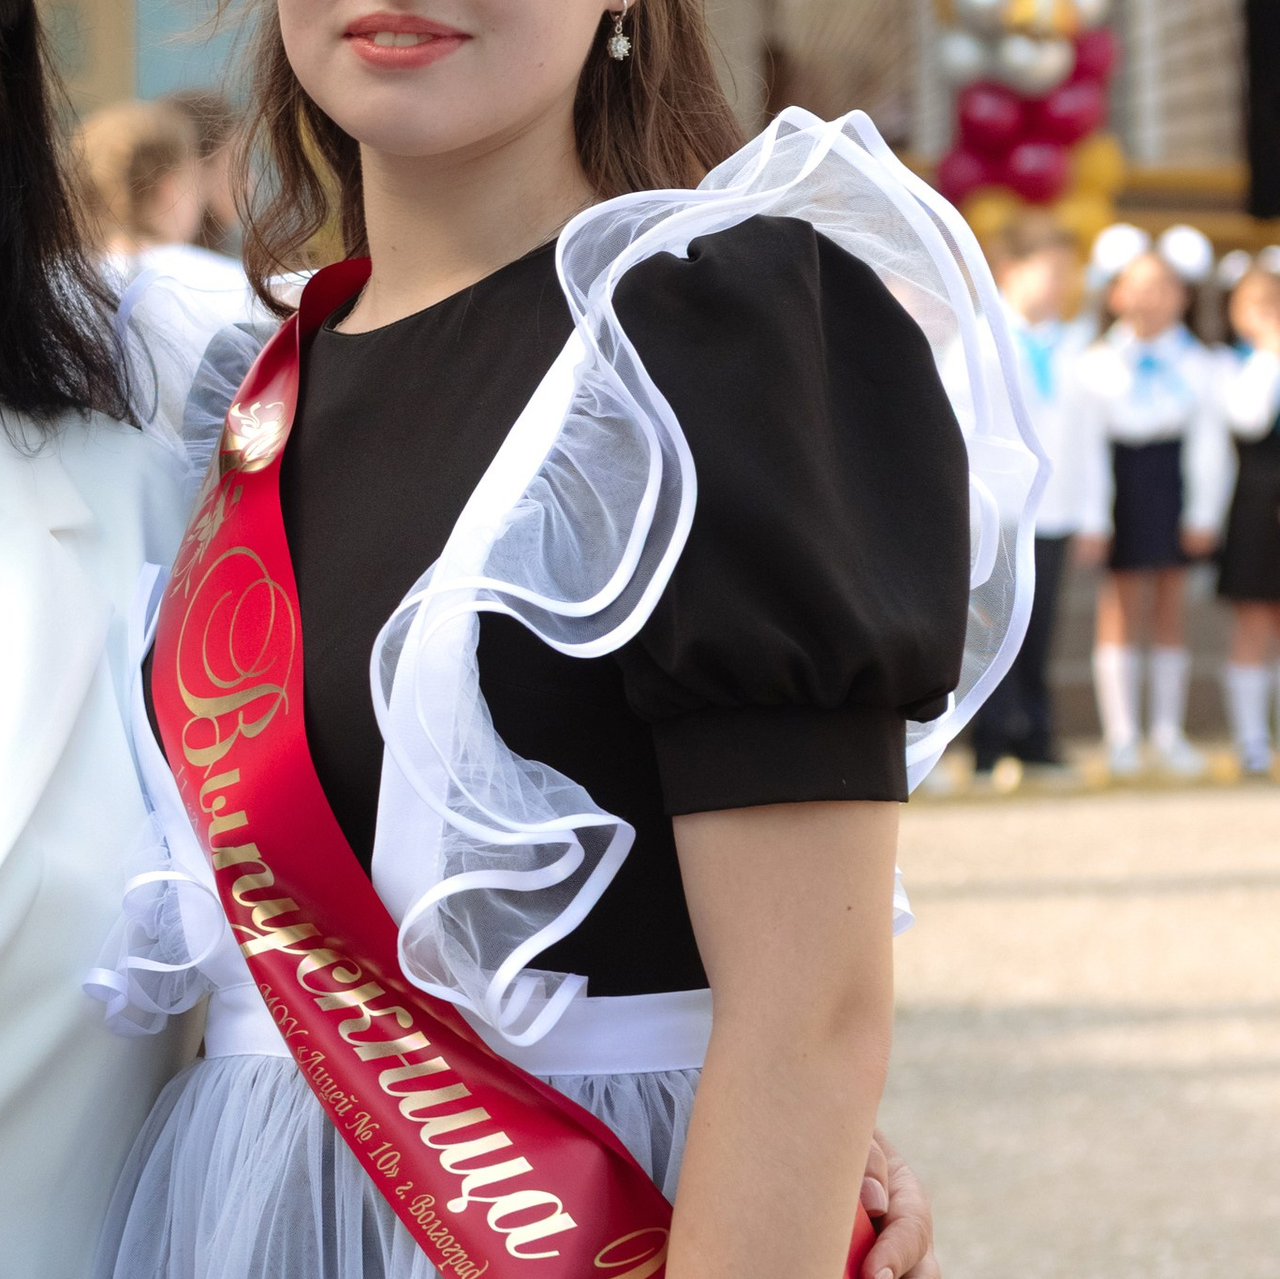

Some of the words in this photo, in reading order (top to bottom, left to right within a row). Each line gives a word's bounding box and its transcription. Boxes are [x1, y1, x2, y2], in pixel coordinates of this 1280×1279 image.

[176, 546, 578, 1260] Выпускница
[297, 1045, 358, 1117] «Лицей
[345, 1111, 380, 1144] №
[367, 1141, 401, 1178] 10»
[395, 1181, 413, 1200] г.
